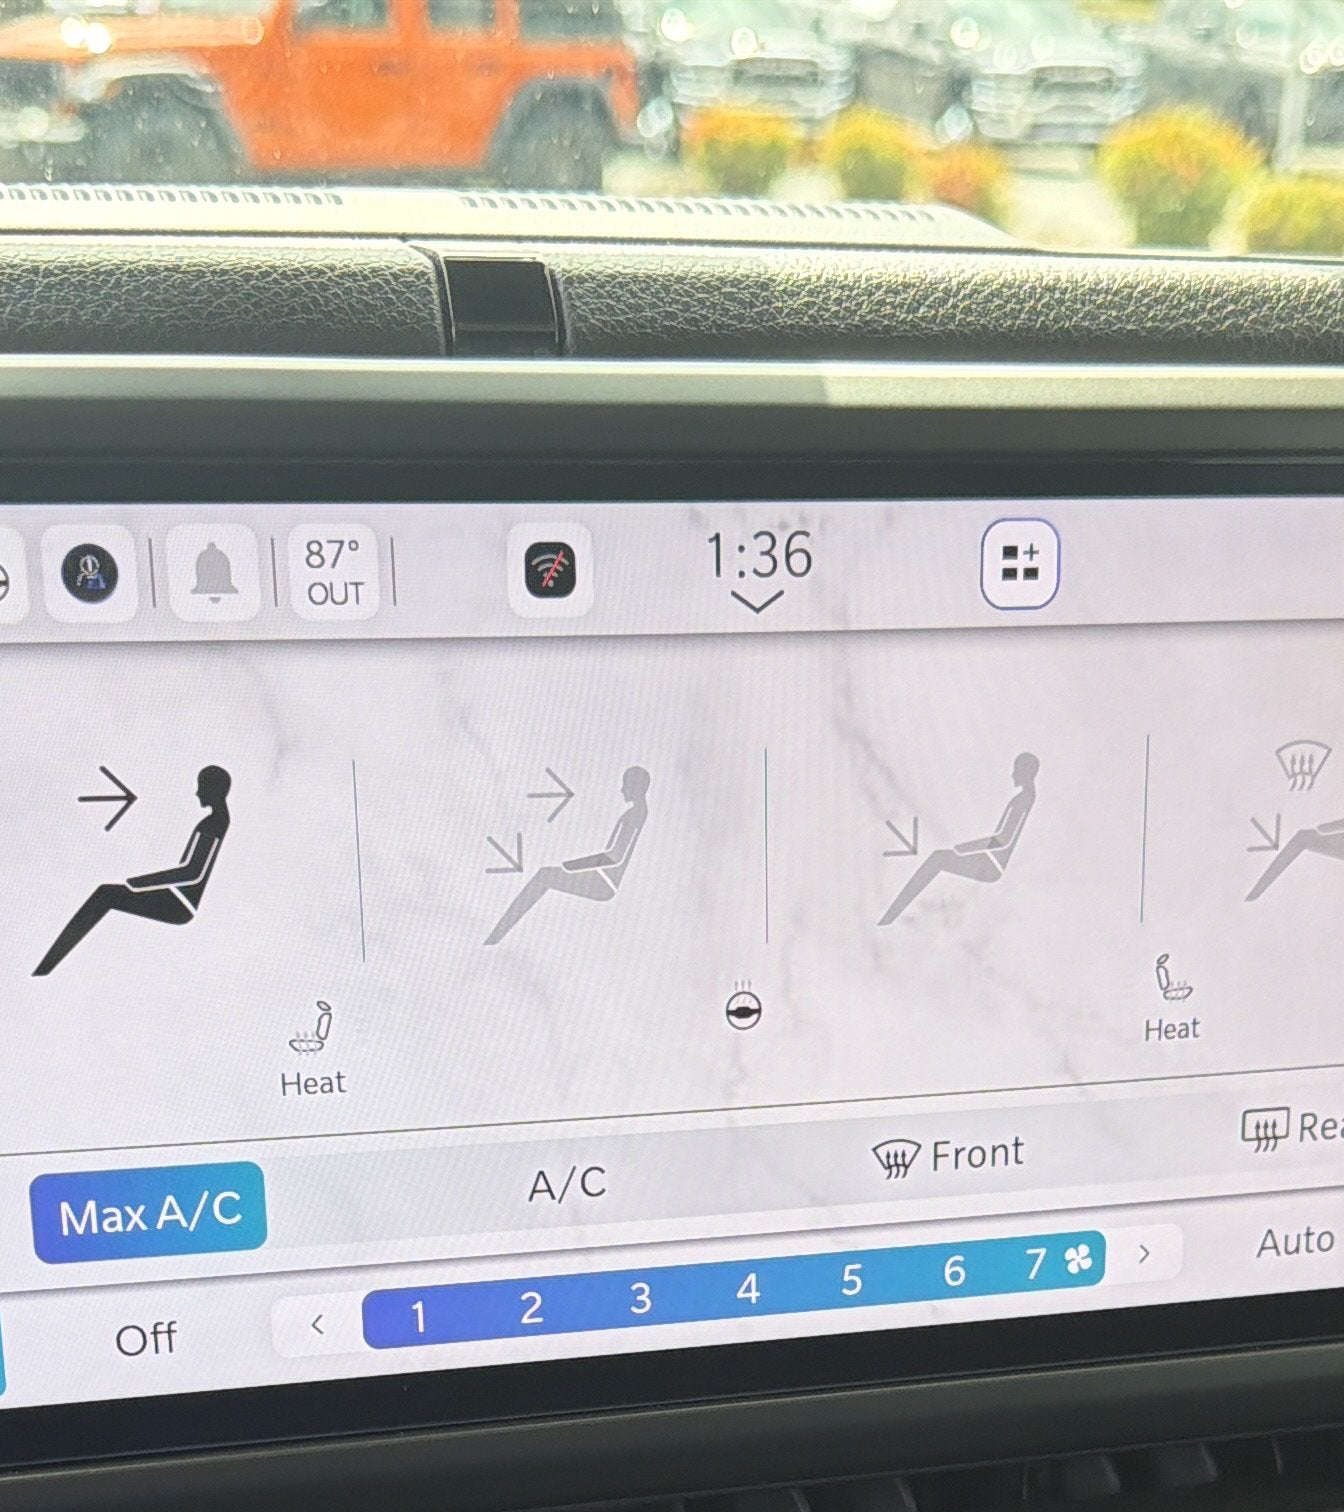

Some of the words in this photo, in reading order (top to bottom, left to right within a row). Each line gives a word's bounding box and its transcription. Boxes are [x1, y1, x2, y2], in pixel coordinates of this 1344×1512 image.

[706, 530, 813, 581] 1:36
[307, 582, 364, 607] OUT
[1144, 1017, 1201, 1042] Heat
[280, 1070, 347, 1098] Heat
[931, 1137, 1025, 1172] Front
[528, 1166, 608, 1204] A/C
[60, 1199, 150, 1236] Max
[156, 1190, 243, 1231] A/C
[1256, 1226, 1336, 1259] Auto
[410, 1301, 426, 1333] 1
[520, 1292, 544, 1324] 2
[629, 1283, 653, 1314] 3
[736, 1273, 761, 1304] 4
[840, 1263, 863, 1296] 5
[943, 1255, 966, 1287] 6
[1025, 1247, 1047, 1279] 7
[115, 1321, 178, 1357] Off
